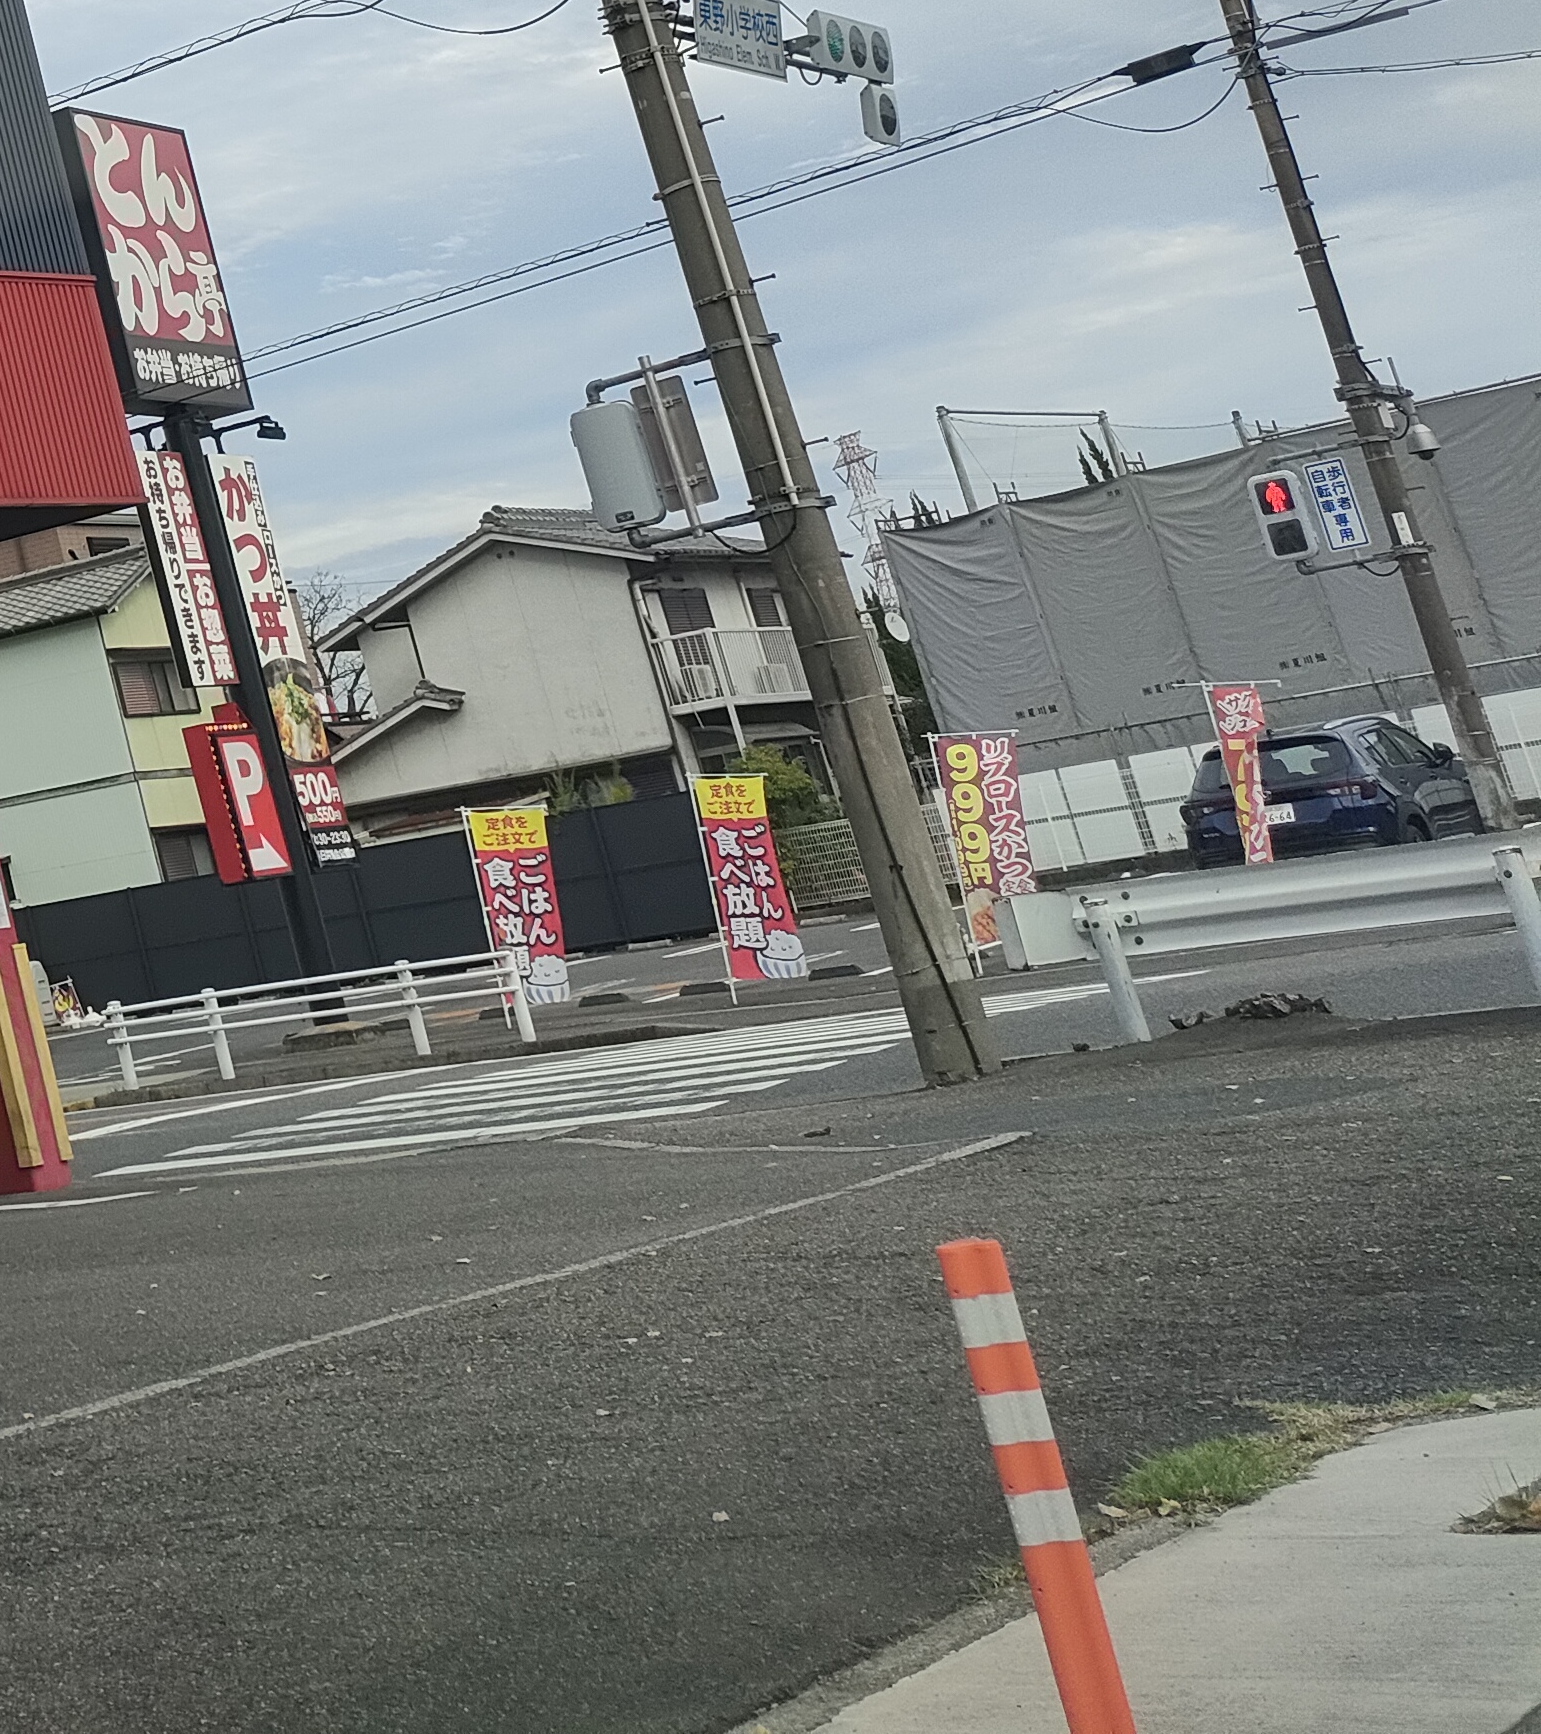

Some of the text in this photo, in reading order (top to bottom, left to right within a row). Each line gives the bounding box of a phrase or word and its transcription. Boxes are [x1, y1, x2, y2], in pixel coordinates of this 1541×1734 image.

[700, 36, 733, 60] Higashino
[74, 114, 196, 233] とん
[163, 456, 204, 561] お弁当
[1311, 470, 1336, 513] 自転車
[1326, 465, 1352, 510] 歩行者
[1333, 512, 1356, 543] 専用
[143, 456, 205, 682] お持ち帰りできます
[218, 466, 289, 656] かつ丼
[263, 530, 286, 605] ロースかつ
[223, 741, 265, 827] P
[293, 772, 341, 806] 500円
[706, 798, 757, 816] ご注文で
[709, 782, 747, 800] 定食を
[482, 829, 539, 847] ご注文で
[485, 815, 529, 831] 定食を
[946, 744, 993, 885] 999円
[1265, 811, 1292, 823] 6-64
[518, 853, 556, 947] ごはん
[711, 826, 768, 950] 食べ放題
[740, 823, 784, 921] ごはん
